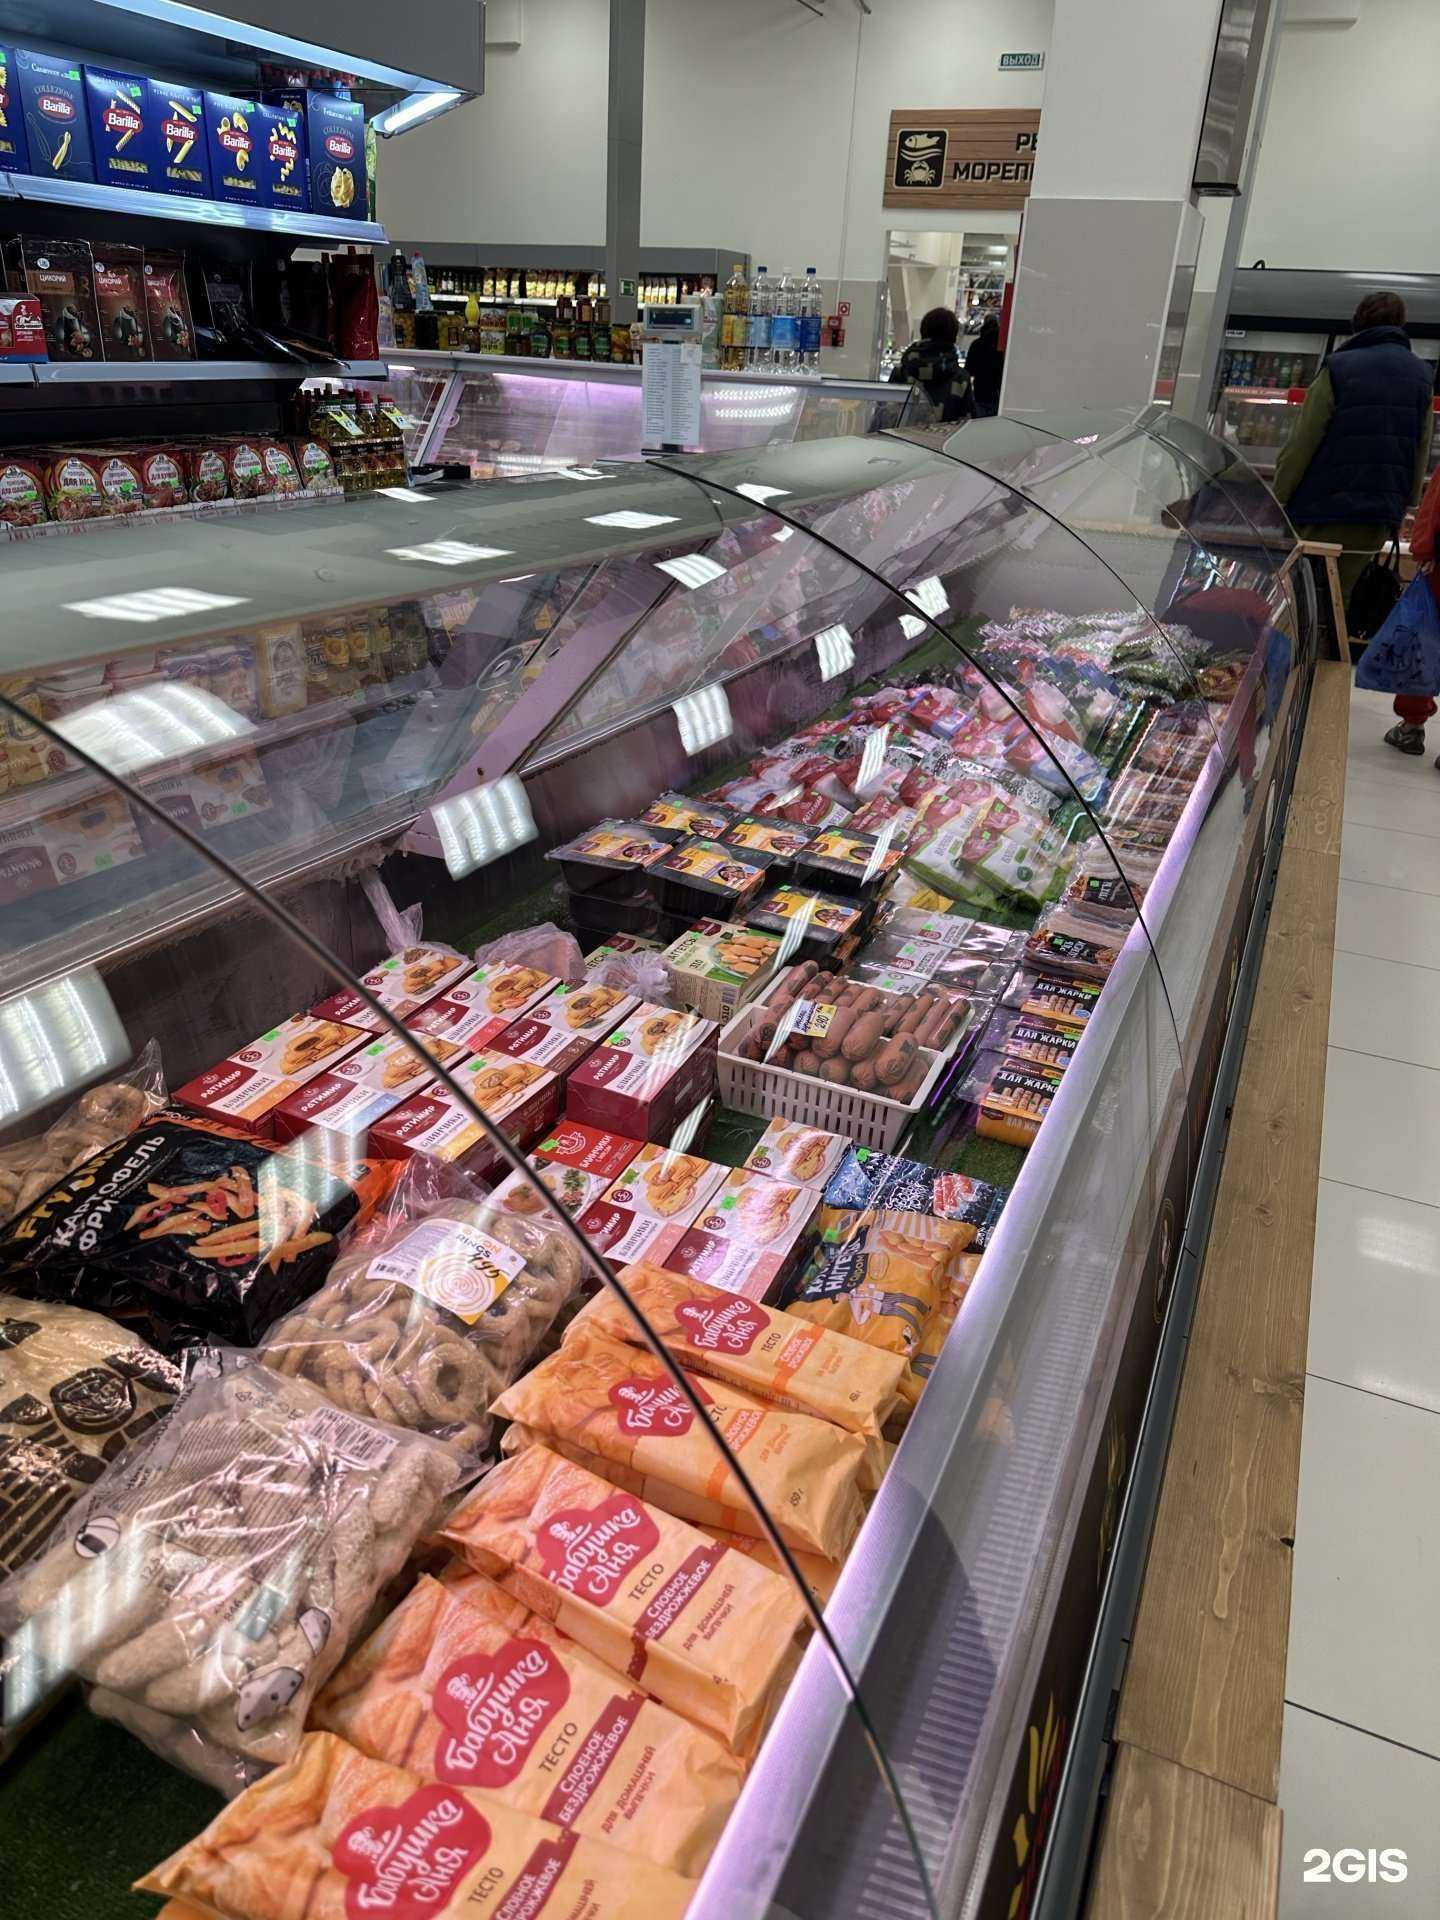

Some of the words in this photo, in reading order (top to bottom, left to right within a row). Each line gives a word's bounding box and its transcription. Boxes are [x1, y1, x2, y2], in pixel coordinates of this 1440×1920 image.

[1003, 54, 1039, 66] ВЫХОД
[43, 99, 71, 115] Barilla
[108, 112, 139, 130] Barilla
[166, 123, 194, 140] Barilla
[223, 134, 251, 150] Barilla
[272, 144, 296, 158] Barilla
[329, 140, 351, 155] Barilla
[1037, 983, 1055, 992] ДЛЯ
[1058, 987, 1092, 1000] ЖАРКИ
[1016, 1028, 1038, 1040] ДЛЯ
[1040, 1034, 1077, 1049] ЖАРКИ
[999, 1071, 1022, 1083] ДЛЯ
[52, 1136, 165, 1247] КАРТОФЕЛЬ
[79, 1199, 119, 1251] ФРИ
[695, 1299, 751, 1349] Бабушка
[727, 1317, 757, 1348] Аня
[761, 1332, 782, 1353] ТЕСТО
[548, 1507, 641, 1594] Бабушка
[588, 1543, 640, 1595] Аня
[628, 1563, 665, 1601] ТЕСТО
[645, 1559, 711, 1640] БЕЗДРОЖЖЕВОЕ
[646, 1571, 690, 1619] СЛОЕНОЕ
[682, 1632, 698, 1651] ДЛЯ
[697, 1583, 735, 1633] ДОМАШНЕЙ
[445, 1649, 550, 1772] Бабушка
[493, 1695, 550, 1767] Аня
[539, 1721, 579, 1774] ТЕСТО
[557, 1714, 629, 1822] БЕЗДРОЖЖЕВОЕ
[561, 1729, 604, 1794] СЛОЕНОЕ
[601, 1811, 618, 1835] ДЛЯ
[616, 1746, 657, 1812] ДОМАШНЕЙ
[624, 1770, 656, 1821] ВЫПЕЧКИ
[358, 1798, 464, 1911] Бабушка
[407, 1846, 470, 1903] Аня
[467, 1867, 505, 1904] ТЕСТО
[496, 1873, 537, 1920] СЛОЕНОЕ
